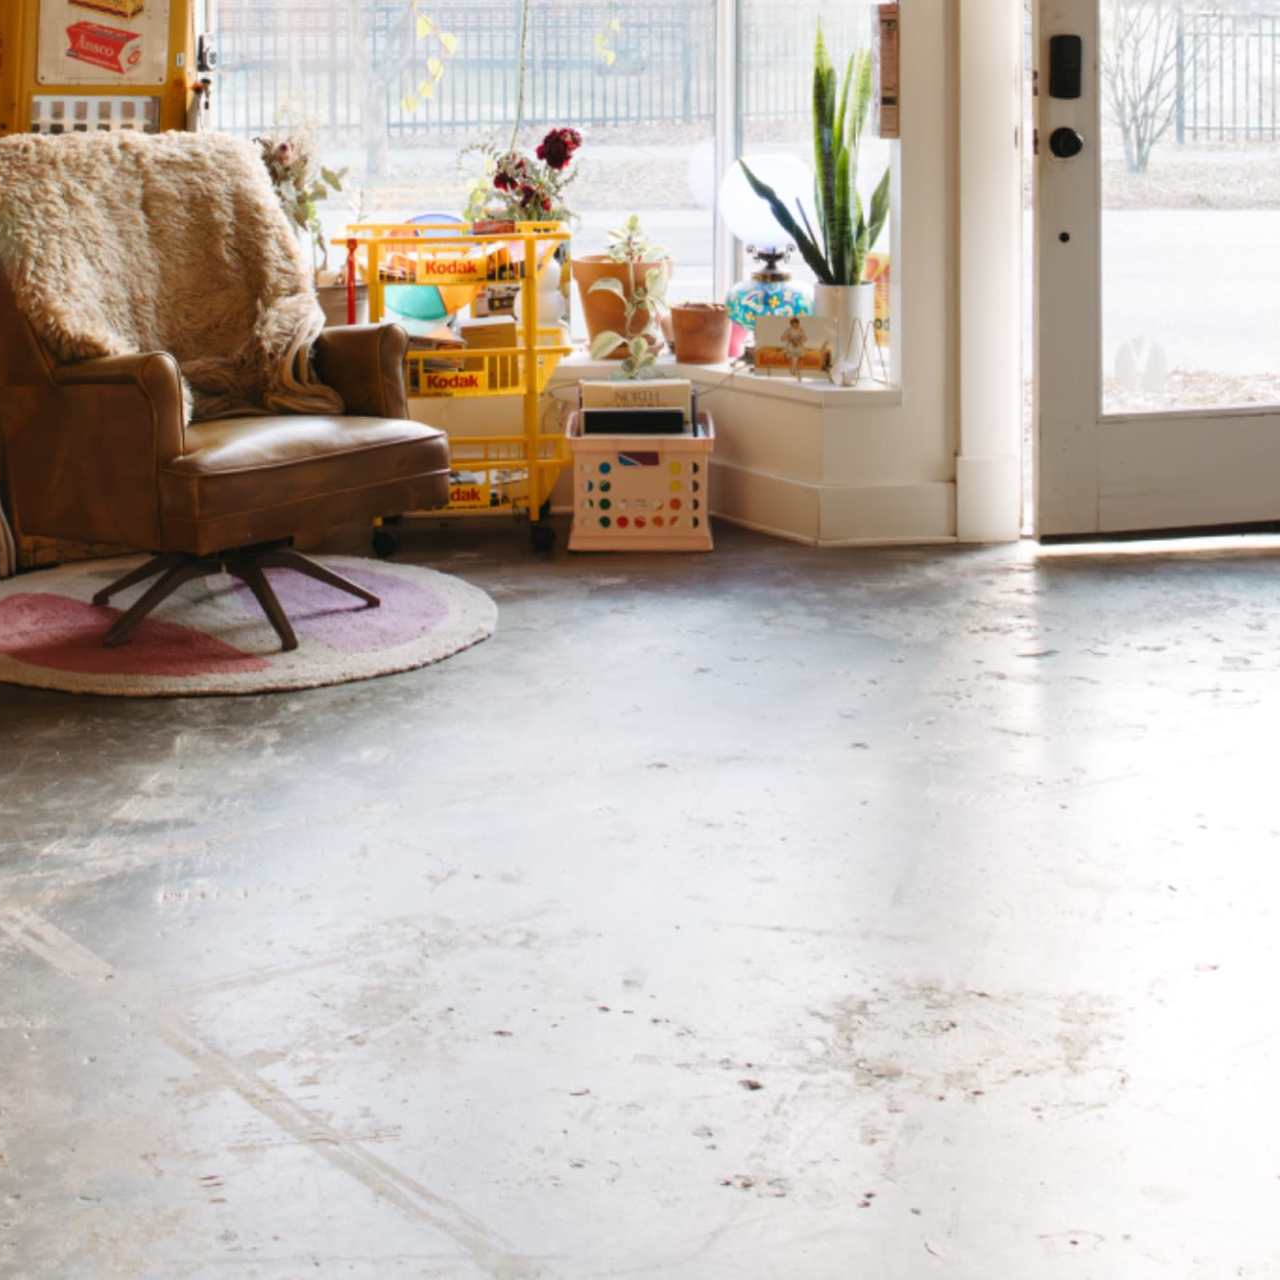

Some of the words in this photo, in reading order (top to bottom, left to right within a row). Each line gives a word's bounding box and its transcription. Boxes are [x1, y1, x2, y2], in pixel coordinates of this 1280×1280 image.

[425, 260, 477, 275] Kodak
[426, 375, 479, 389] Kodak
[450, 488, 481, 502] dak
